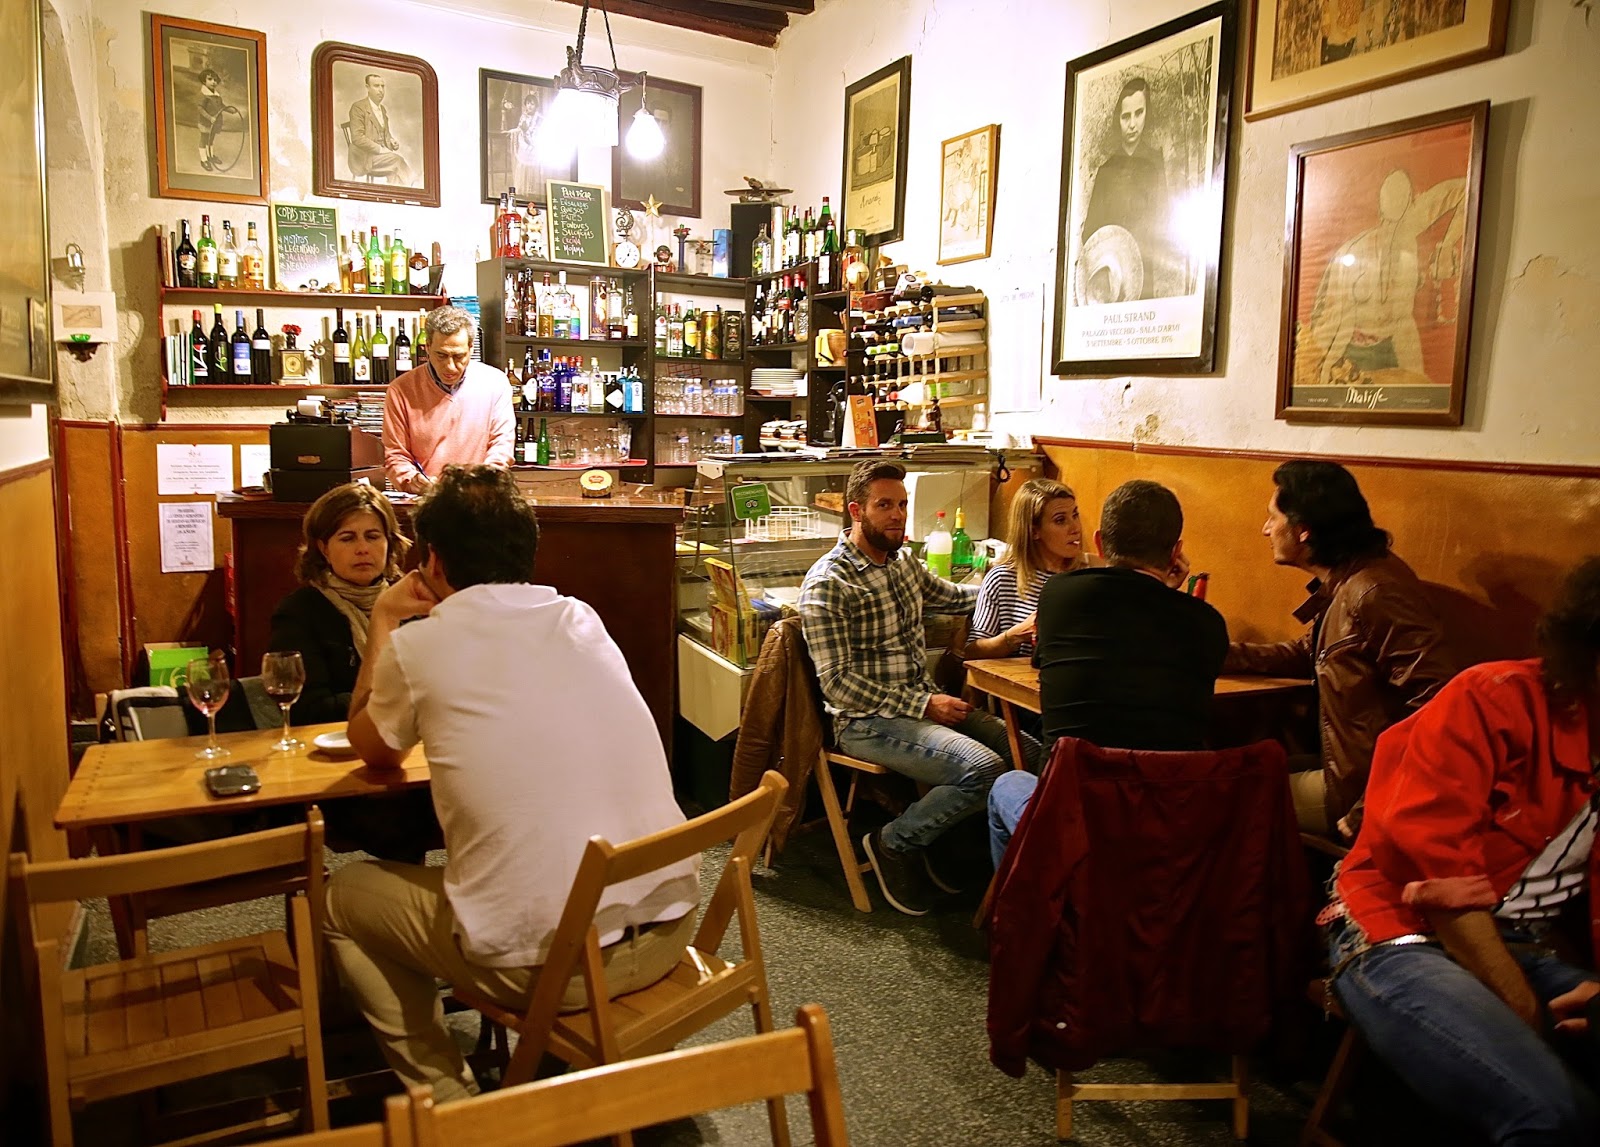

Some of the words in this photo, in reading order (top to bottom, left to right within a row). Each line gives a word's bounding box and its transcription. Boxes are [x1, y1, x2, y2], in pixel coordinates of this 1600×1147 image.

[1103, 314, 1122, 325] PAUL
[1124, 311, 1156, 322] STRAND
[1081, 329, 1108, 338] PALAZZO
[1109, 327, 1136, 336] VECCHIO
[1131, 336, 1160, 345] OTTOBRE
